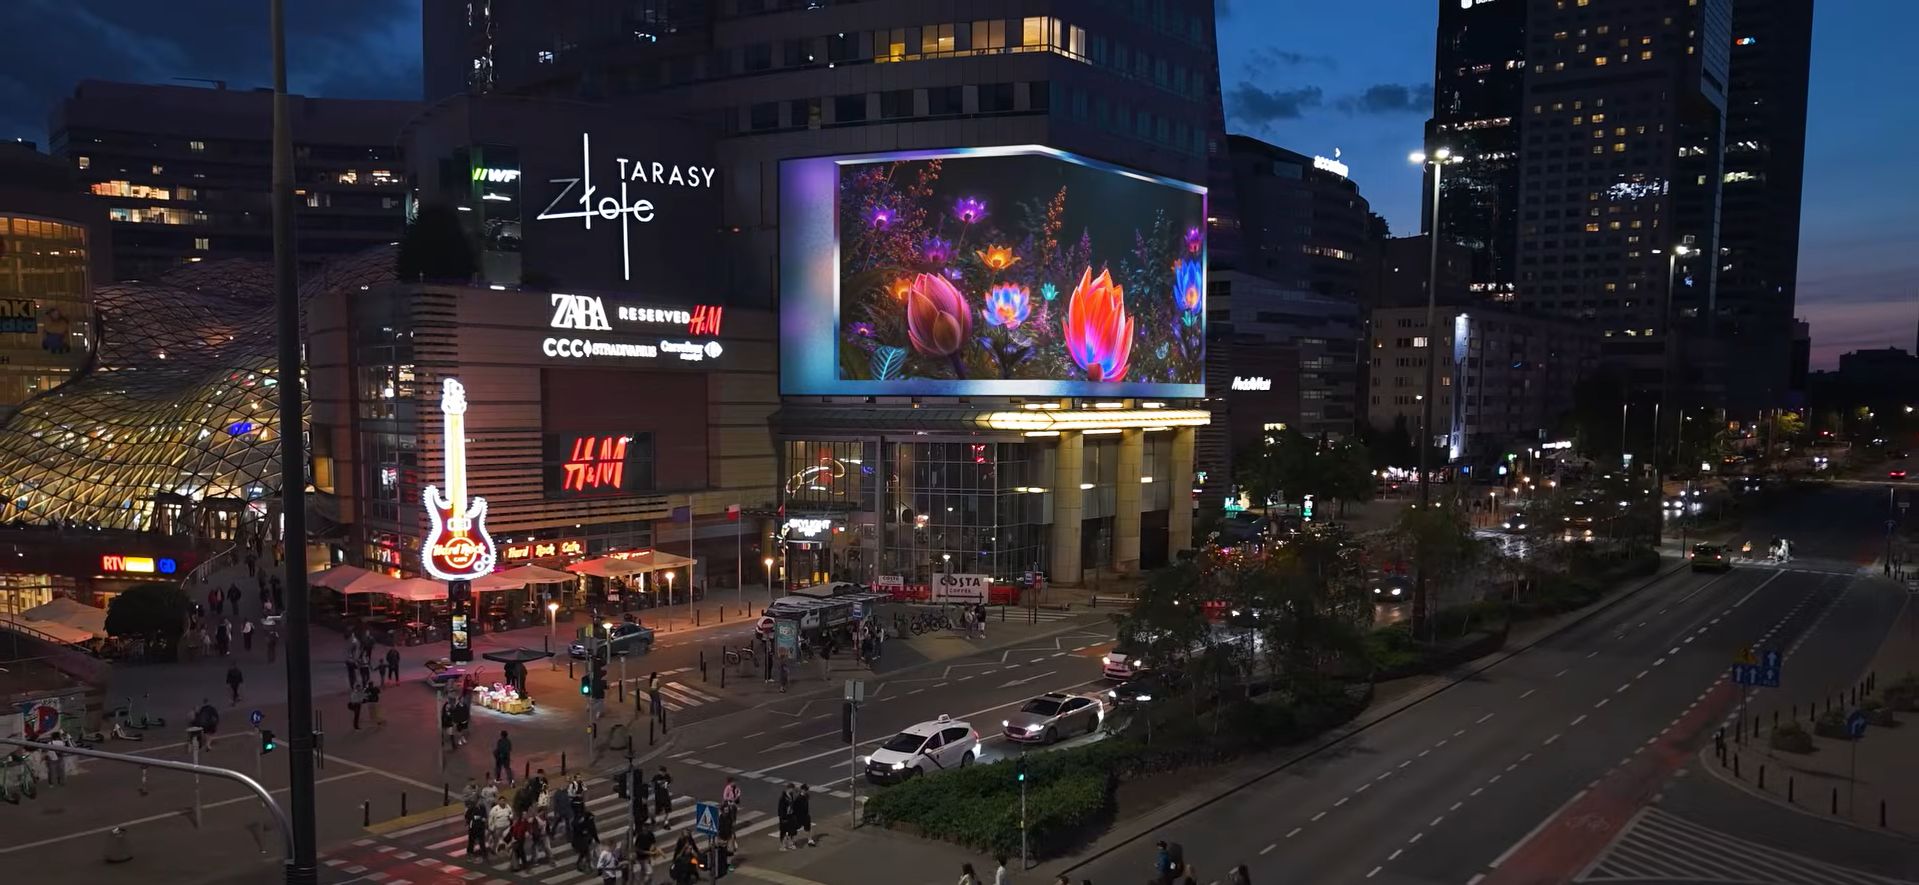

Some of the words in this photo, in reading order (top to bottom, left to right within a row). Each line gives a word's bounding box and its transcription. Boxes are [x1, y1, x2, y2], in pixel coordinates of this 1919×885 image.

[616, 158, 715, 188] TARASY
[537, 132, 654, 280] Złote
[550, 293, 612, 331] ZARA
[618, 306, 691, 325] RESERVED
[690, 304, 723, 337] H&M
[543, 338, 584, 358] CCC
[592, 342, 658, 358] STRADIVARIUS
[562, 436, 627, 491] H&M
[508, 545, 529, 559] Hard
[535, 543, 556, 557] Rock
[561, 541, 581, 553] Cafe
[103, 555, 126, 572] RTV
[940, 577, 981, 587] COSTA
